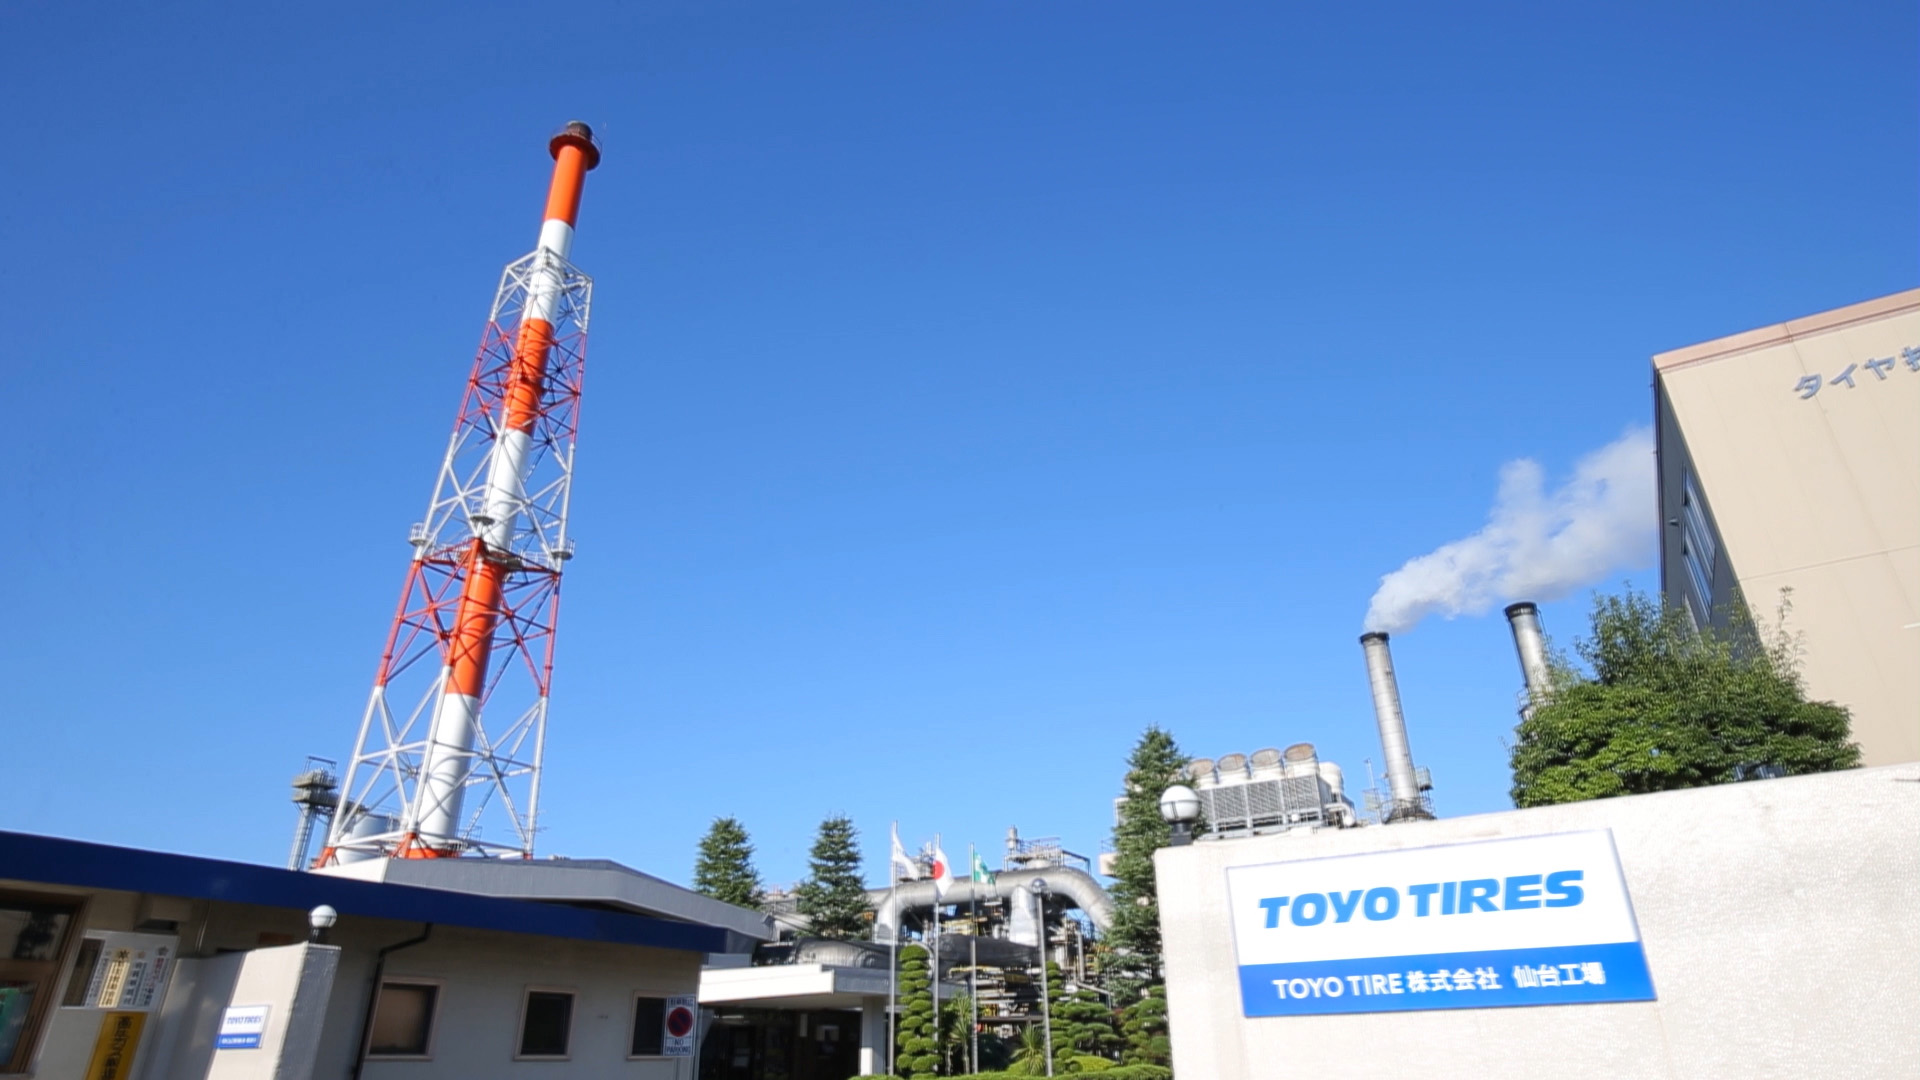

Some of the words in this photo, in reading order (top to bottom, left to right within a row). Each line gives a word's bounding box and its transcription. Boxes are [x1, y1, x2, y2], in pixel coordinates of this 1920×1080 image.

[1258, 886, 1400, 929] TOYO
[1407, 869, 1585, 918] TIRES
[1271, 976, 1345, 1000] TOYO
[1345, 972, 1405, 997] TIRE
[1405, 967, 1503, 993] 株式会社
[1511, 961, 1607, 989] 仙台工場
